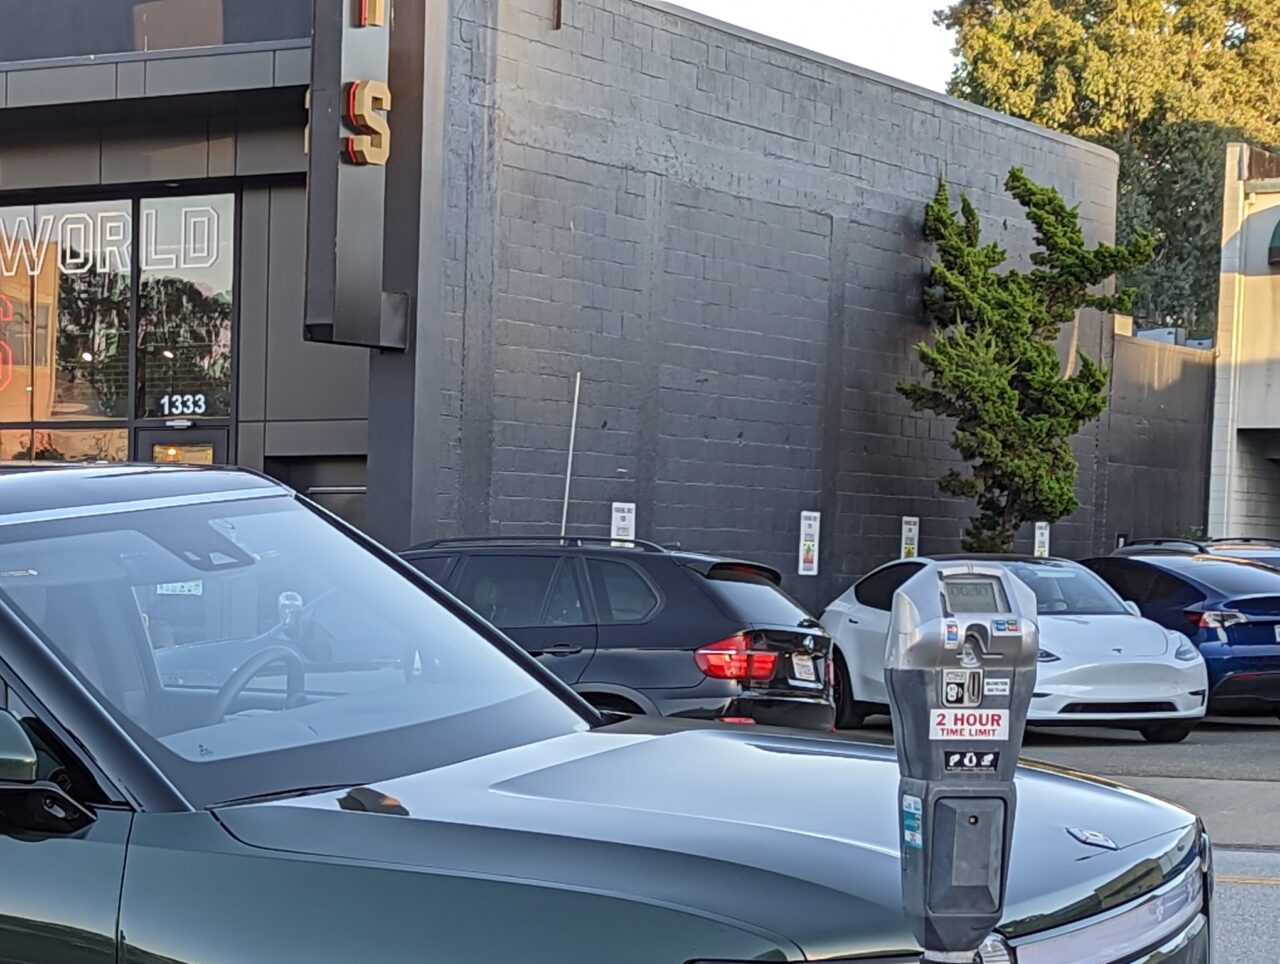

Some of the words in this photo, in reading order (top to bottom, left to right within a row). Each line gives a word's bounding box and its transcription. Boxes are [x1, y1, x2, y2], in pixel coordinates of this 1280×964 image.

[160, 393, 207, 415] 1333
[936, 713, 947, 726] 2
[953, 713, 1002, 727] HOUR
[940, 728, 965, 737] TIME
[968, 728, 997, 737] LIMIT
